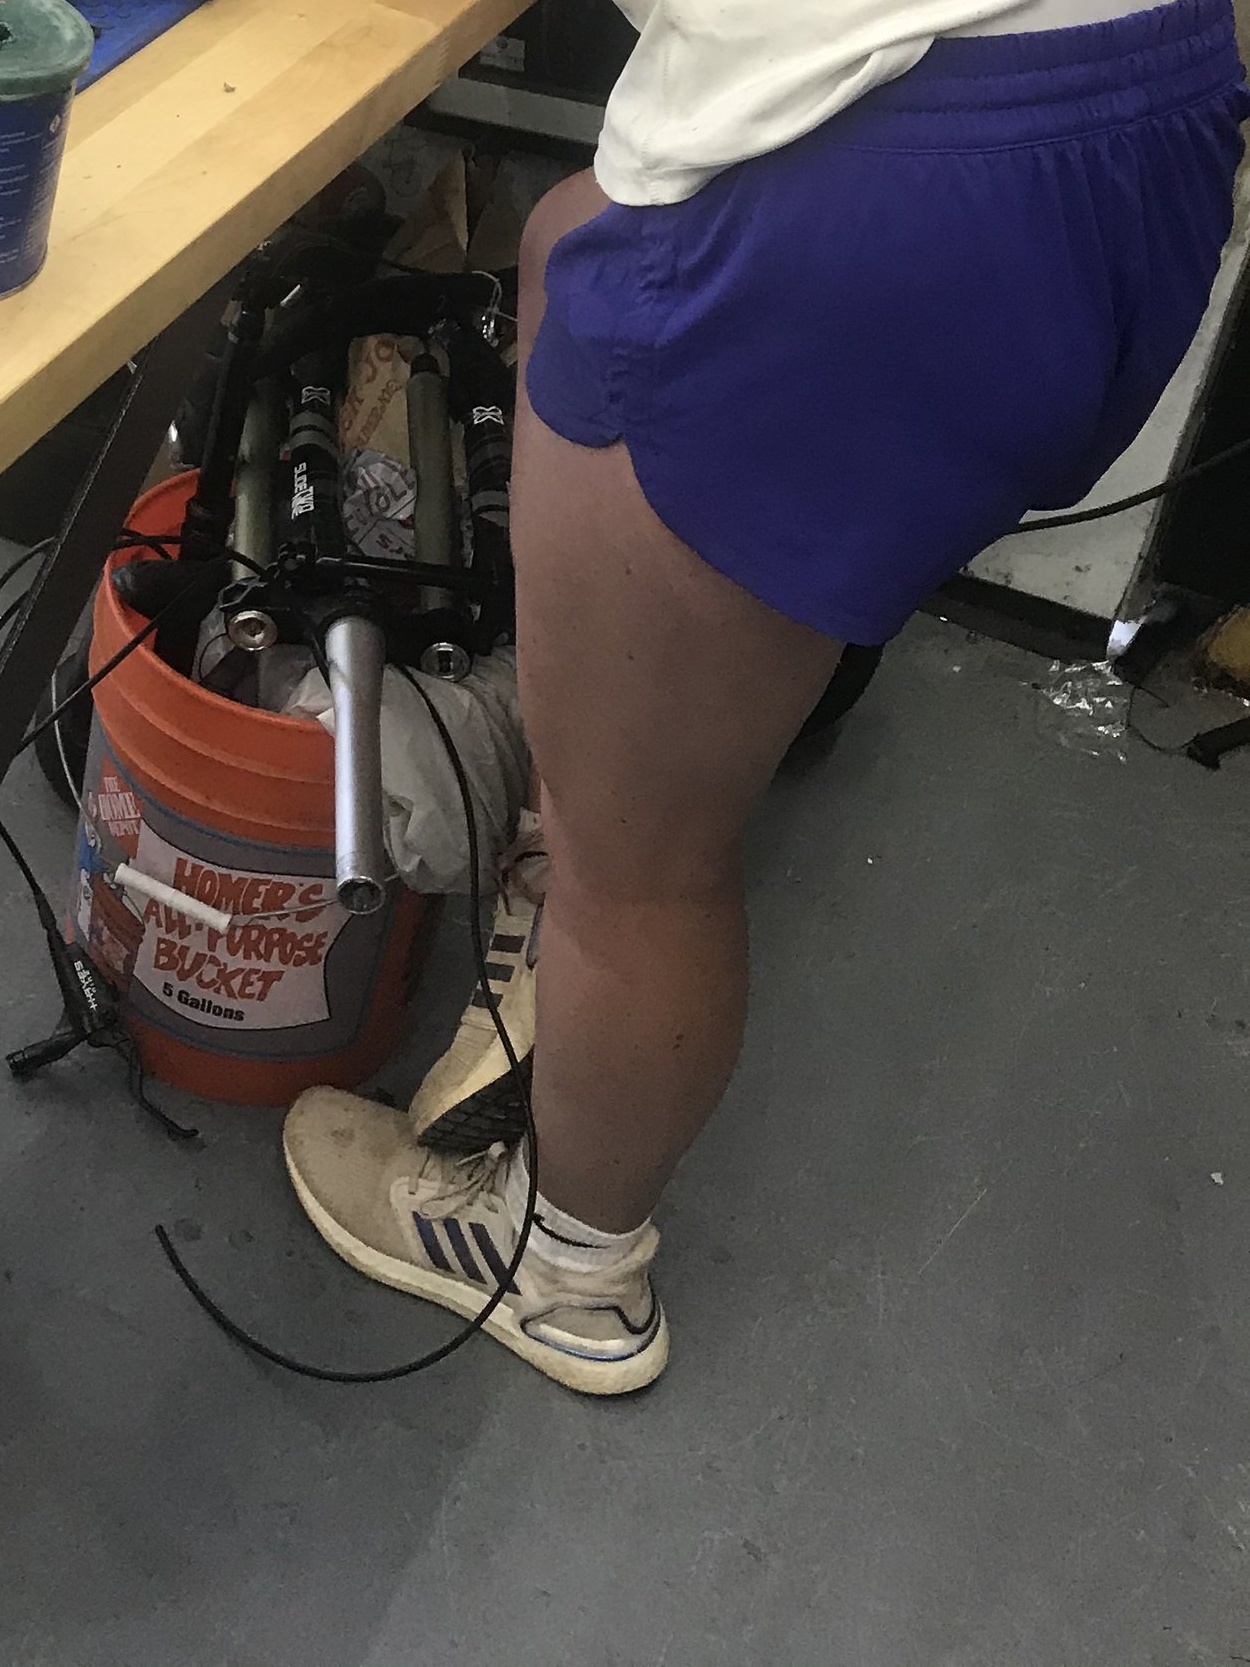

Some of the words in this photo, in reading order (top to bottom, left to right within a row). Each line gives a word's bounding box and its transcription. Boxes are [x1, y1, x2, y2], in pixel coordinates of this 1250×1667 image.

[173, 857, 327, 923] HOMER'S
[154, 936, 285, 1002] BUCKET
[162, 982, 174, 997] 5
[176, 989, 245, 1022] Gallons
